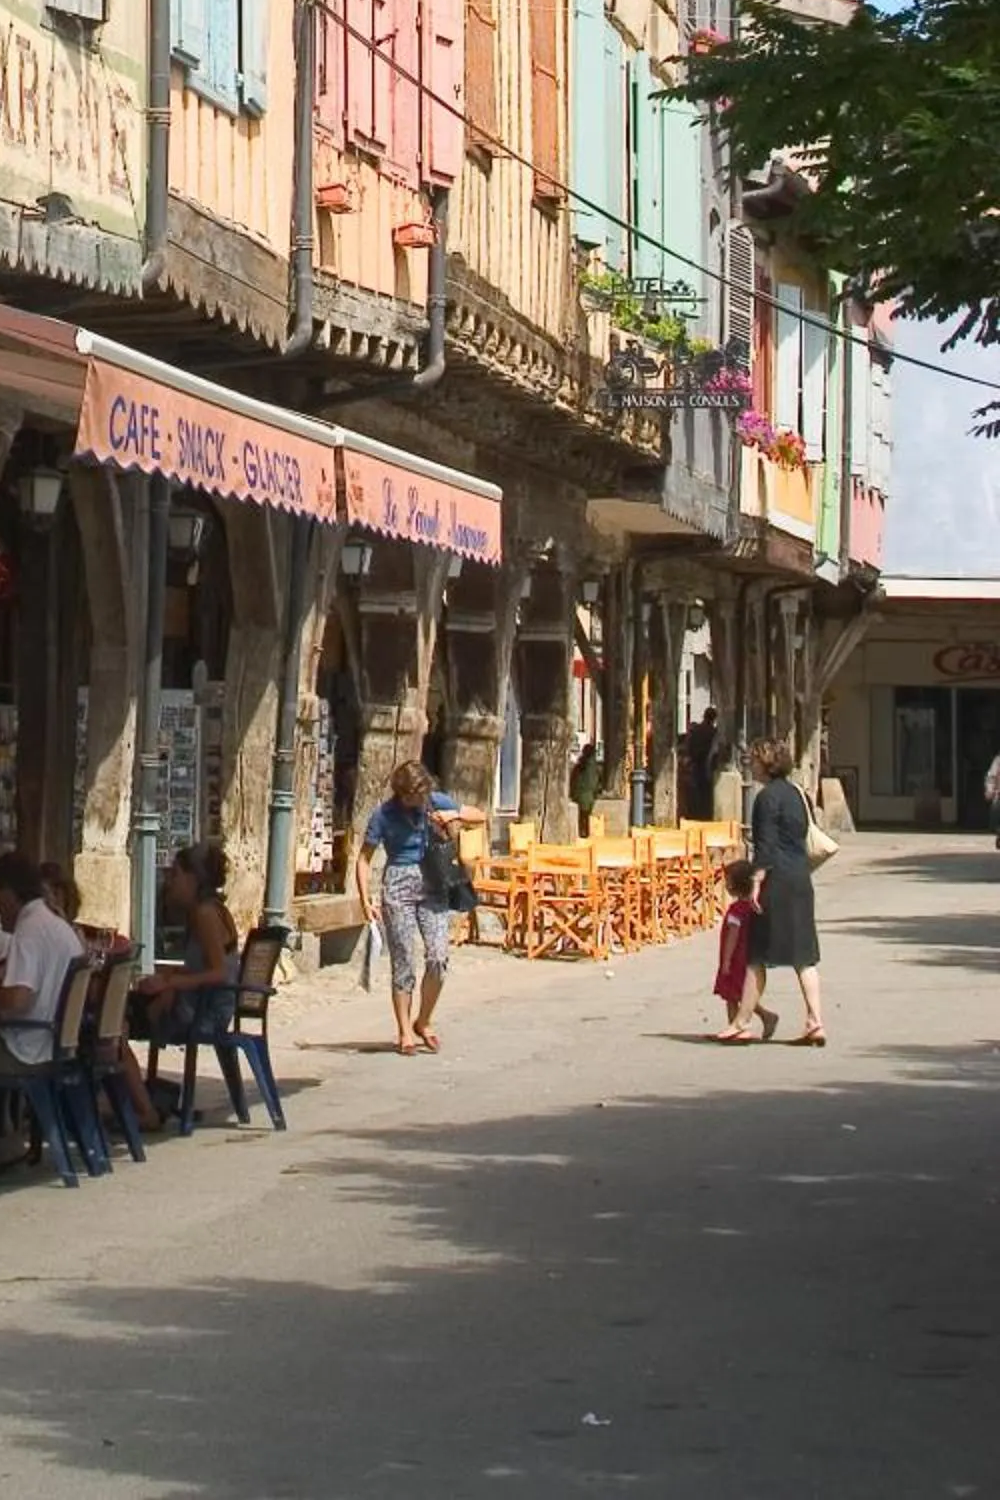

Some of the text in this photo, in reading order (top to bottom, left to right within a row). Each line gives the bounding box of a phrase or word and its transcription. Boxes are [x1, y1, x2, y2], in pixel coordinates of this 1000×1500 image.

[621, 394, 667, 407] MAISON
[689, 394, 741, 407] CONSULS
[109, 395, 161, 460] CAFE
[177, 417, 226, 481] SNACK
[243, 438, 302, 503] GLACIER
